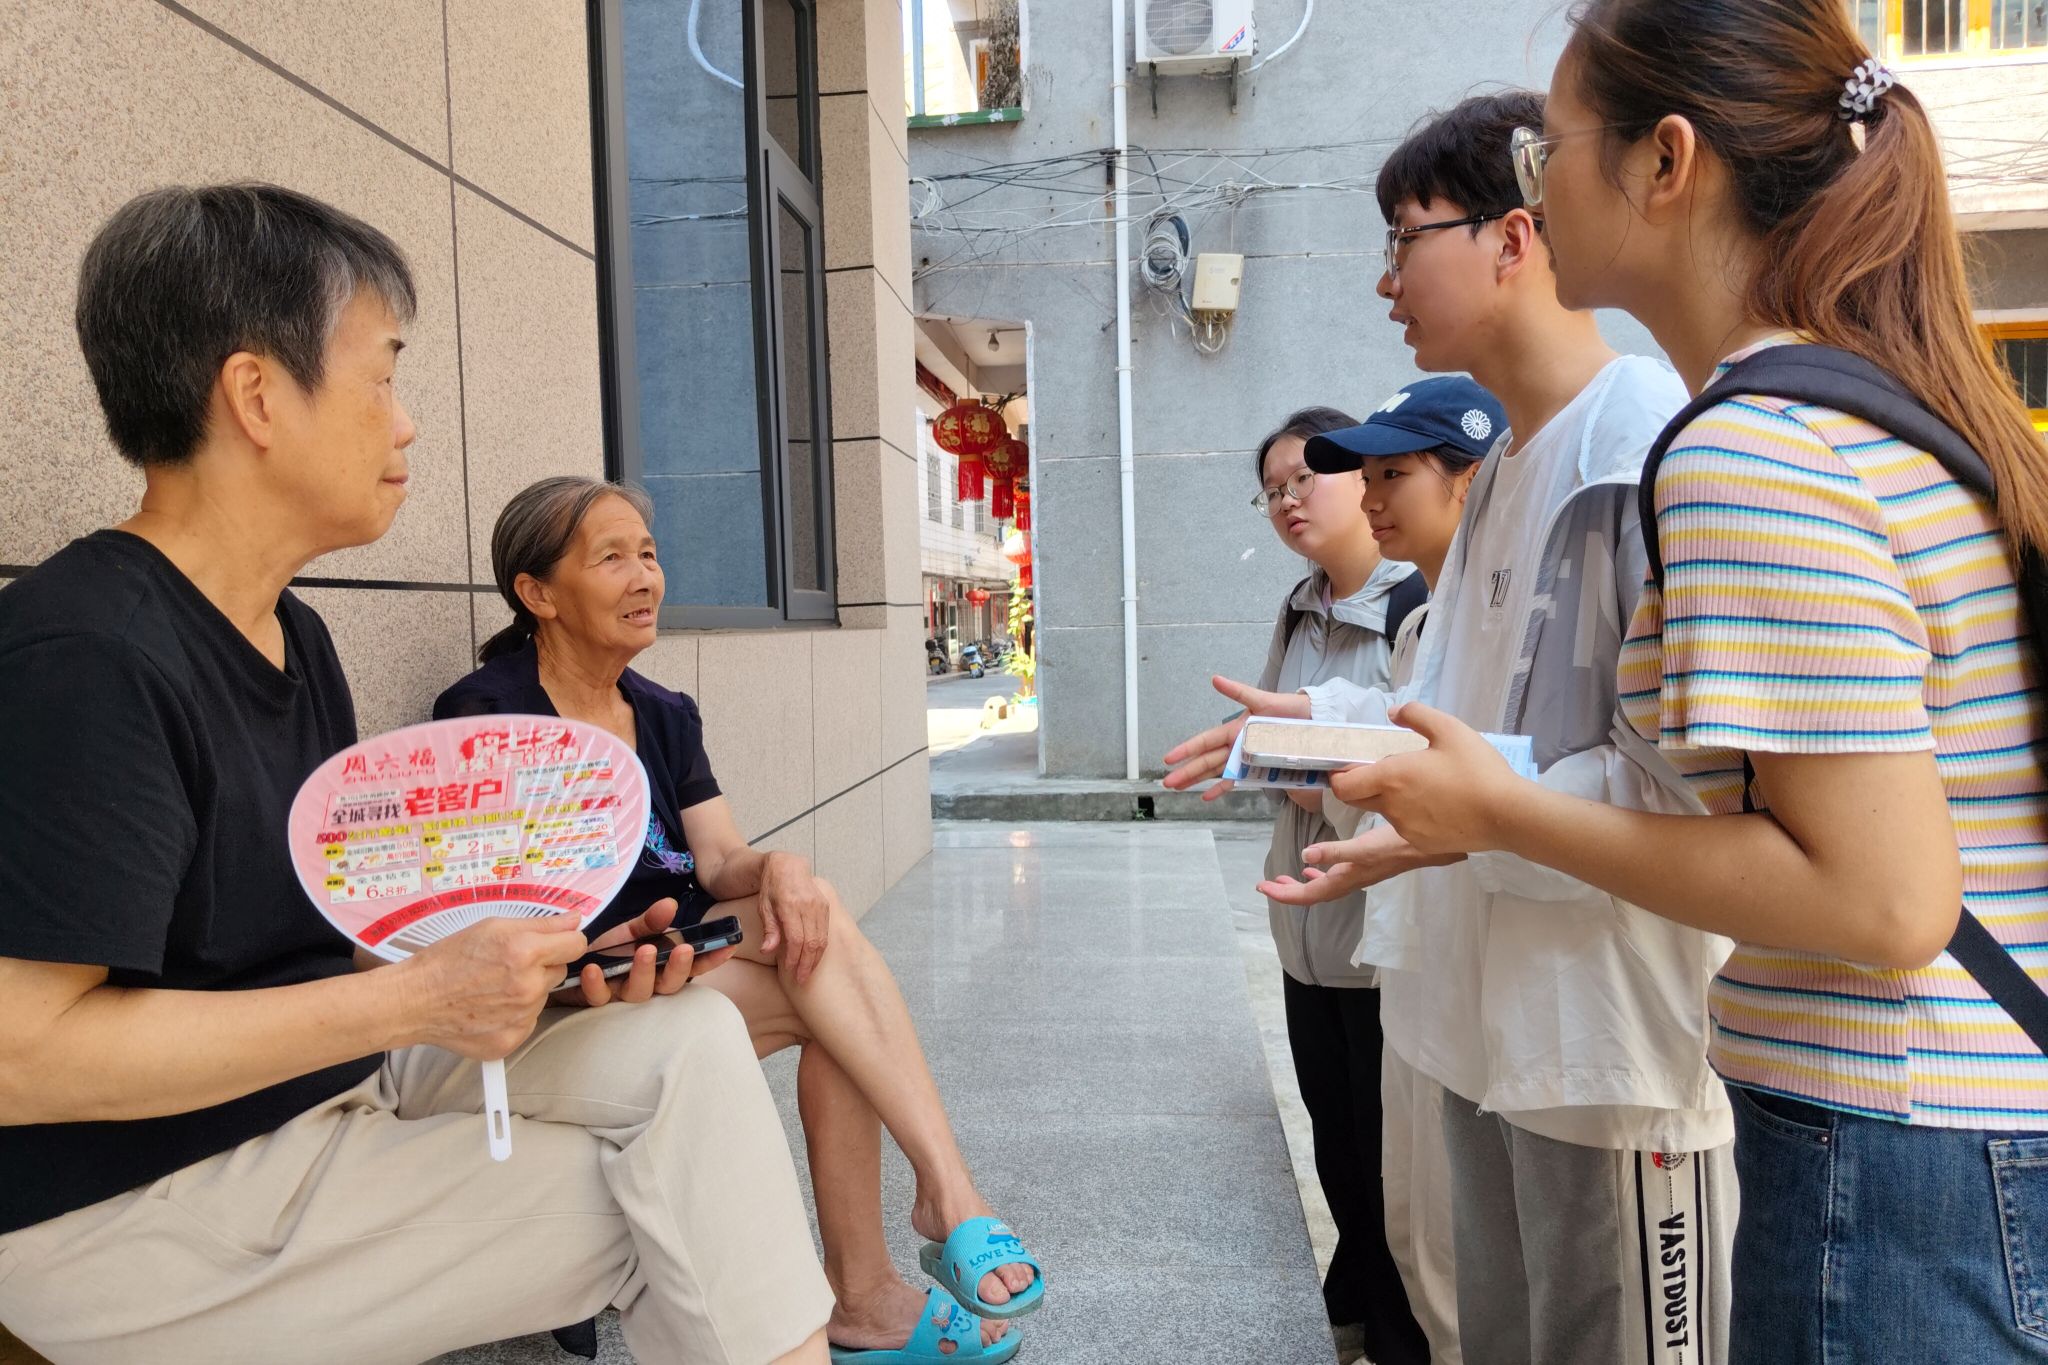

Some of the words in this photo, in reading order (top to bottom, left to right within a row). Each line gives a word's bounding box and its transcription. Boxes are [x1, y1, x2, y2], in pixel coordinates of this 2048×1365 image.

[343, 748, 435, 774] 周六福
[404, 779, 503, 816] 老客户
[331, 802, 402, 826] 全城寻找
[365, 884, 409, 899] 6.8折
[968, 1248, 1004, 1268] LOVE
[1658, 1211, 1689, 1349] VASTDUST
